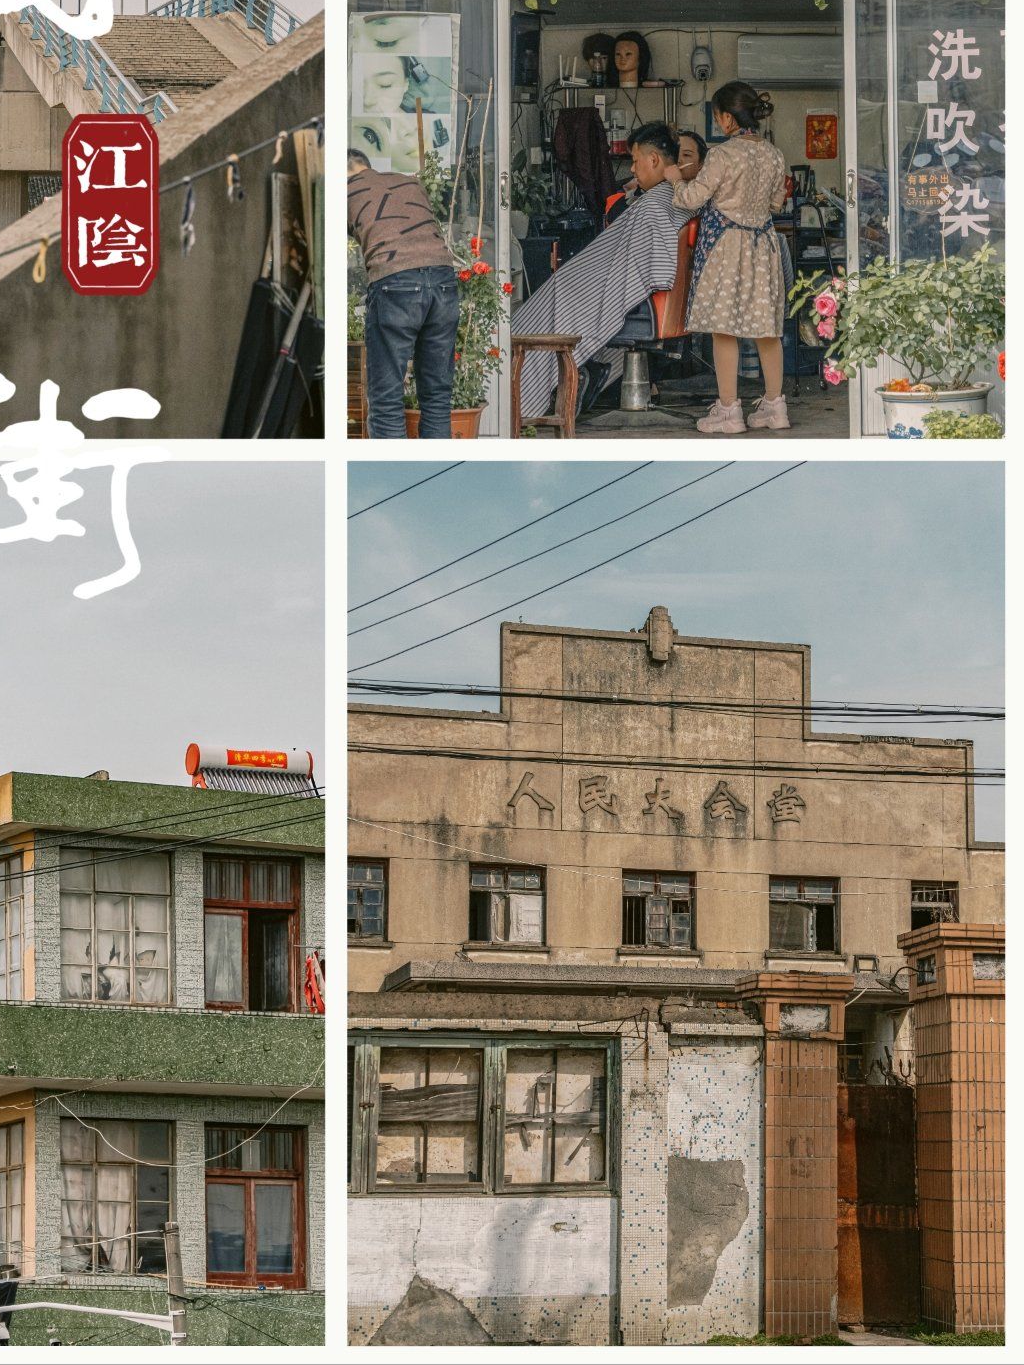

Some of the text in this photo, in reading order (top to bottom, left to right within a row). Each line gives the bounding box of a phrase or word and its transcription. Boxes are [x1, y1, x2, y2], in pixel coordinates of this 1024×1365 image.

[926, 28, 991, 238] 洗吹染
[907, 174, 949, 185] 有事外出
[506, 770, 806, 823] 人民大会堂
